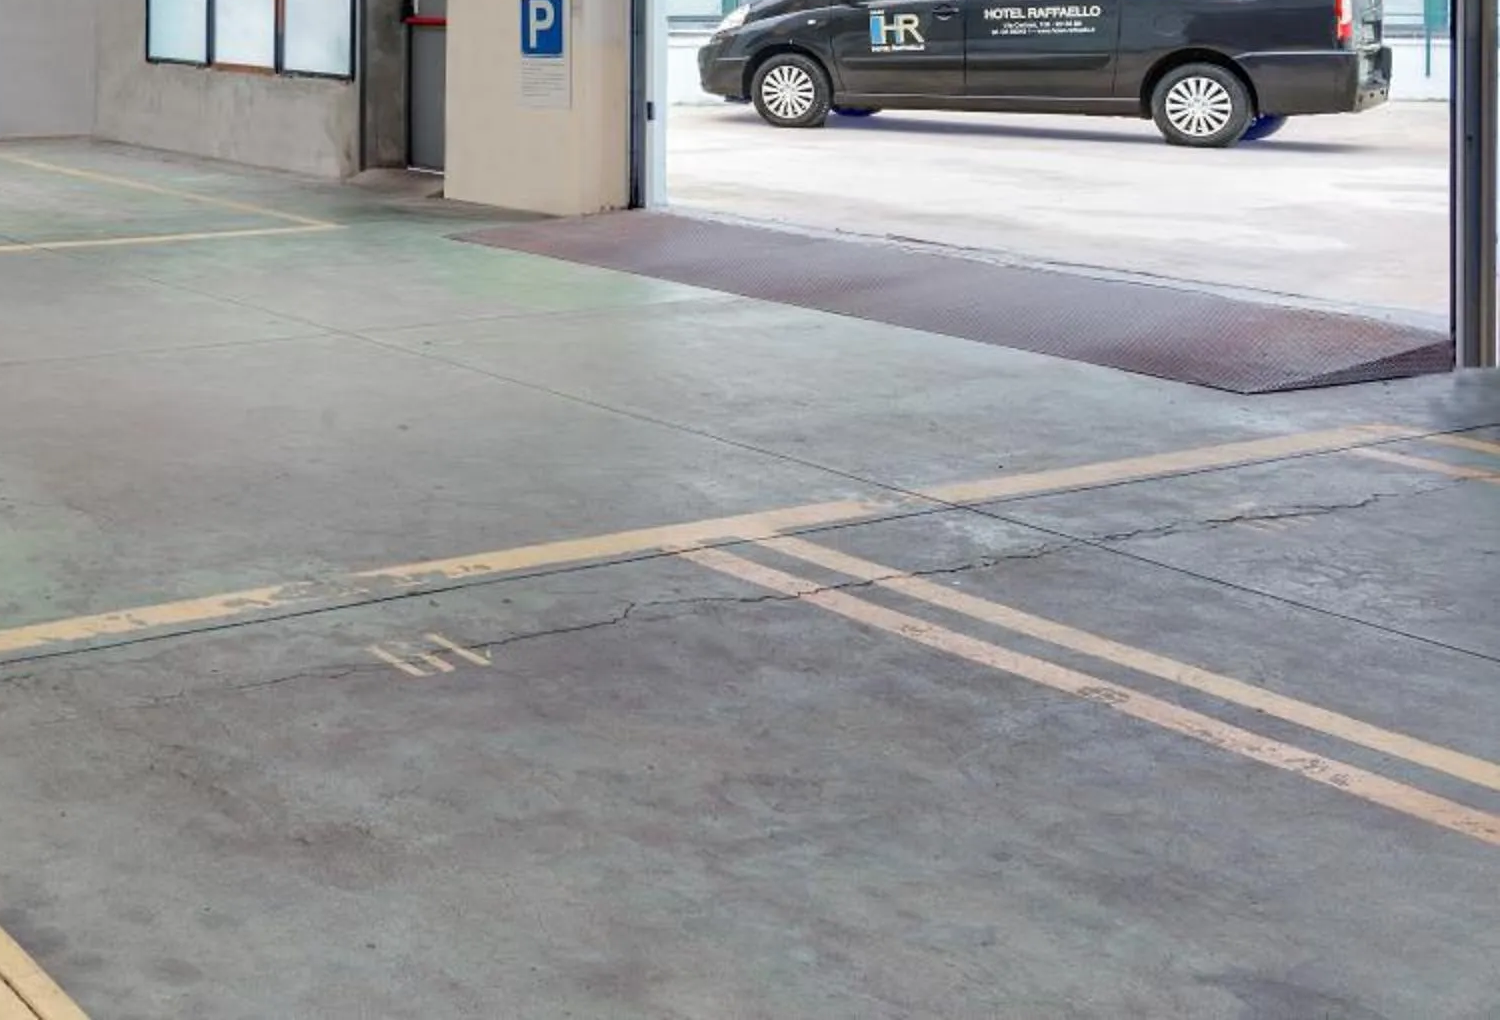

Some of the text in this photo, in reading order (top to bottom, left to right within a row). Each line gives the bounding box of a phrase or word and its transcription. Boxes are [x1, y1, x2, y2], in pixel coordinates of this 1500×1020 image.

[529, 0, 555, 49] P
[984, 5, 1101, 19] HOTEL RAFFAELLO
